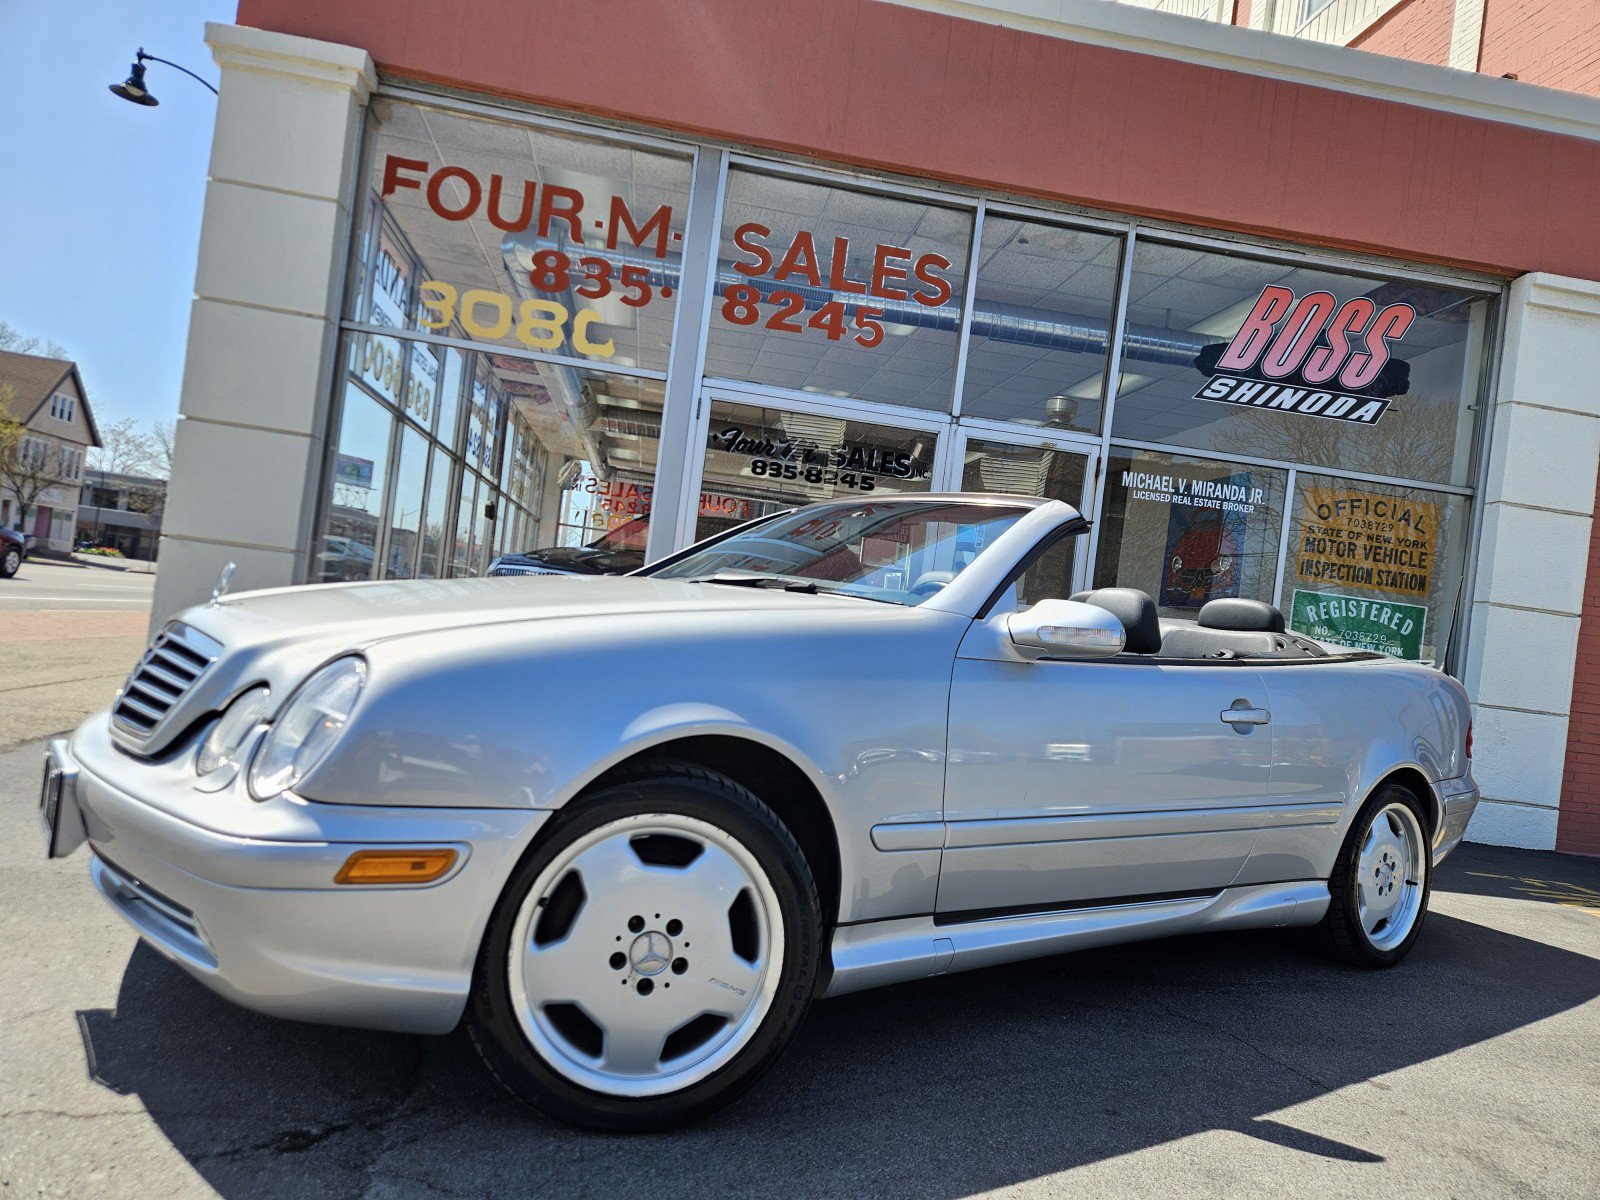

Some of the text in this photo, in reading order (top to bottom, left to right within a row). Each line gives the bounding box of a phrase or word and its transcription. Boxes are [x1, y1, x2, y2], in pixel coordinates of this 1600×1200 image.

[731, 222, 952, 307] SALES
[721, 283, 885, 349] 8245
[1215, 284, 1417, 389] BOSS
[1202, 377, 1384, 422] SHINODA
[830, 443, 912, 479] SALES
[1121, 471, 1266, 505] MICHAEL V. MIRANDA JR.
[1133, 490, 1255, 514] LICENSED REAL ESTATE BROKER
[1316, 498, 1426, 535] OFFICIAL
[1346, 517, 1394, 533] 7038729
[1304, 537, 1429, 570] MOTOR VEHICLE
[1308, 525, 1428, 550] STATE OF NEW YORK
[1300, 558, 1428, 592] INSPECTION STATION
[1306, 600, 1414, 636] REGISTERED
[1340, 629, 1387, 644] 7038729
[1354, 641, 1376, 652] NEW
[1378, 644, 1404, 657] YORK
